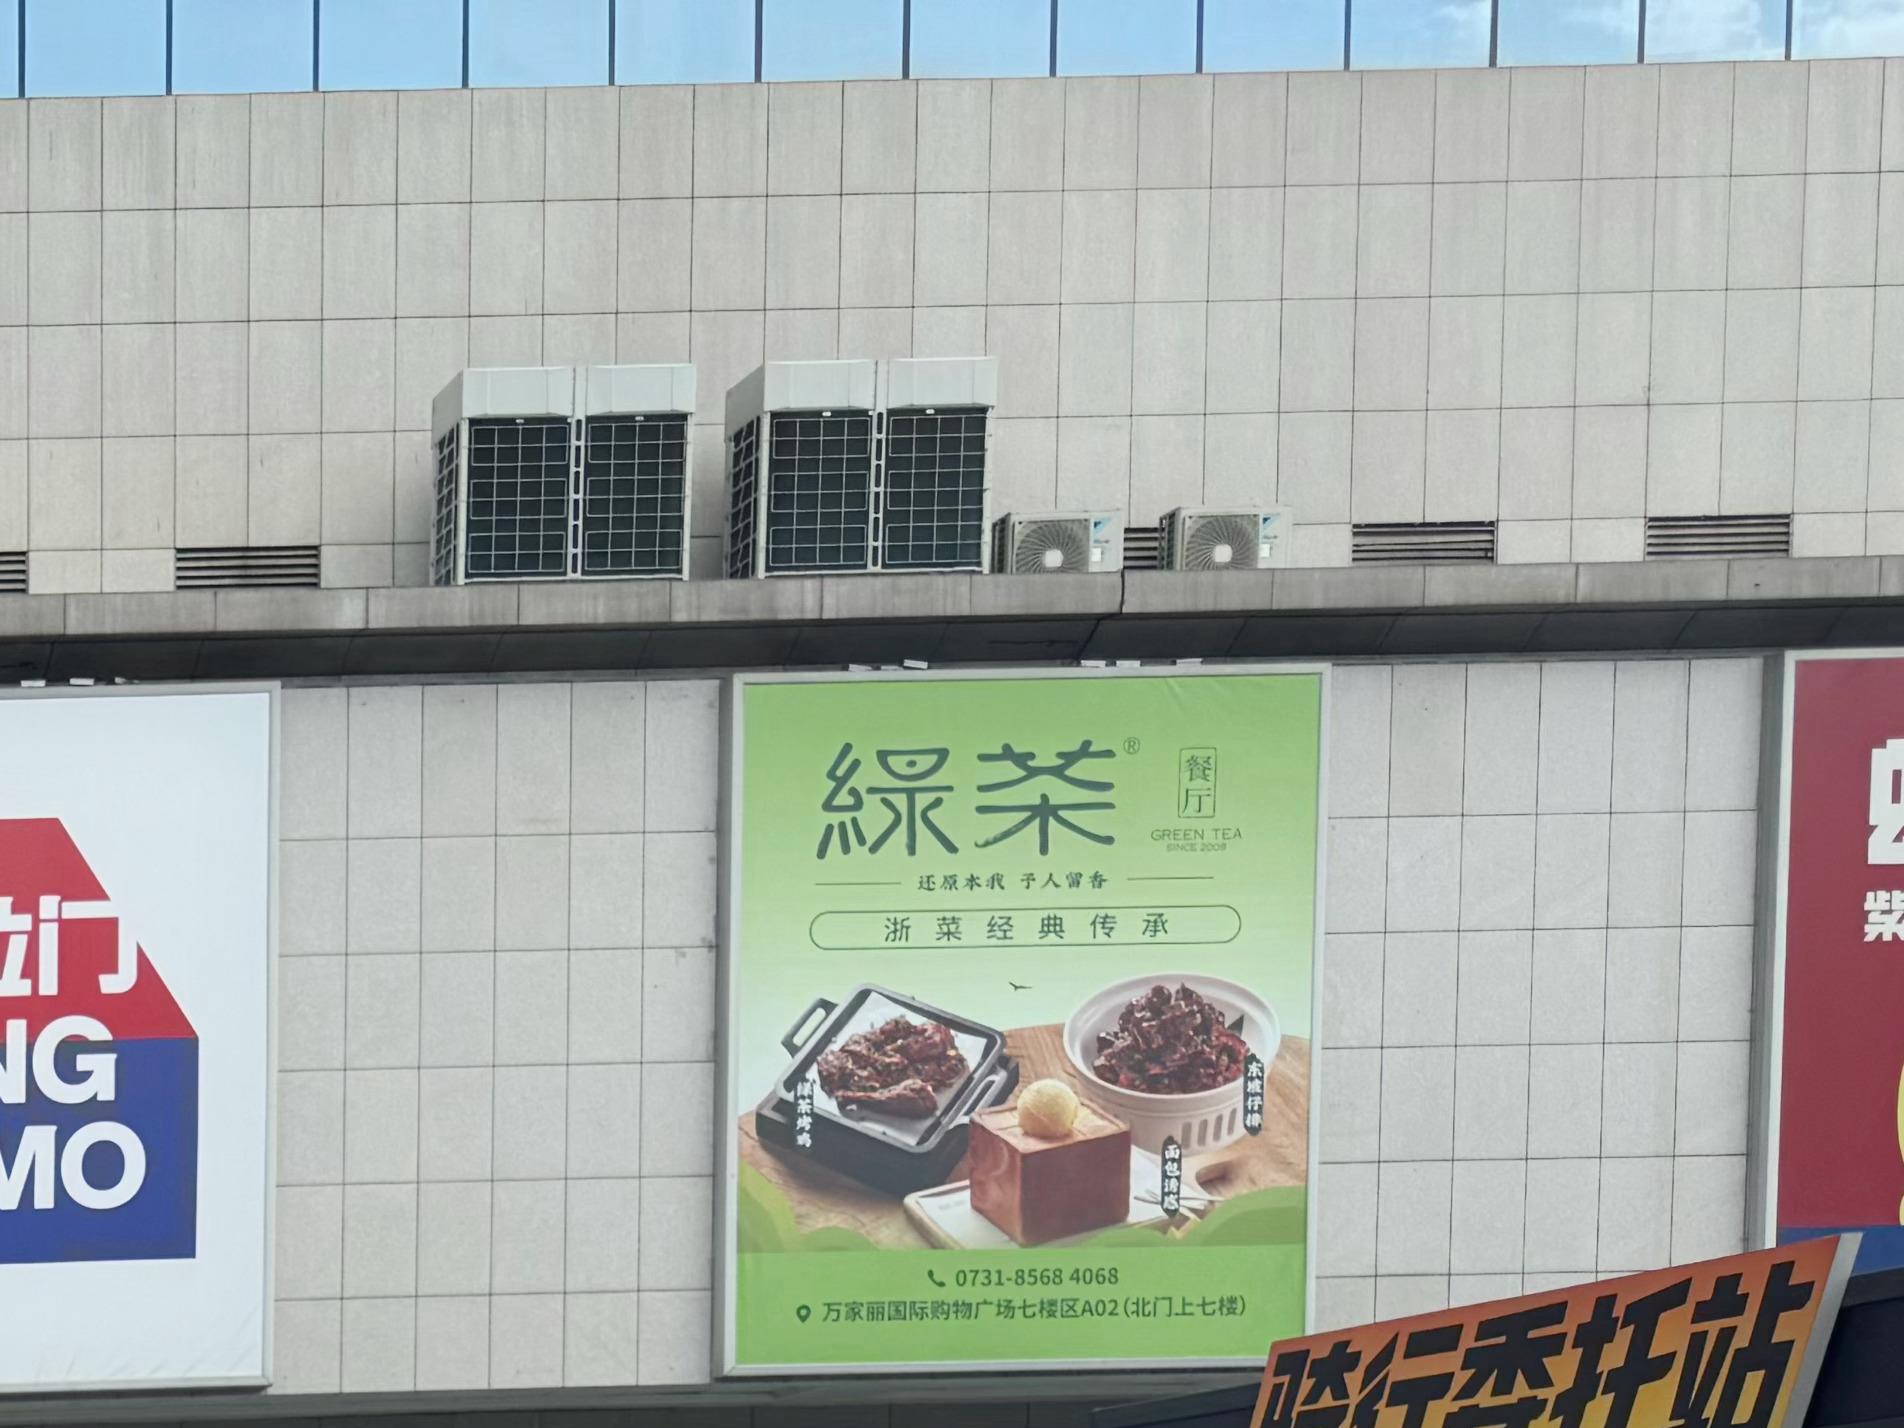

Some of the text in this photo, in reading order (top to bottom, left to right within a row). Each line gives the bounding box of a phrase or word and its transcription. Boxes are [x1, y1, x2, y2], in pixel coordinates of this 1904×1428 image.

[1181, 752, 1212, 815] 餐厅
[1151, 827, 1242, 841] GREEN TEA
[1166, 843, 1197, 852] SINCE
[884, 912, 1169, 943] 浙菜经典传承
[955, 1267, 1120, 1288] 0731-8568 4068
